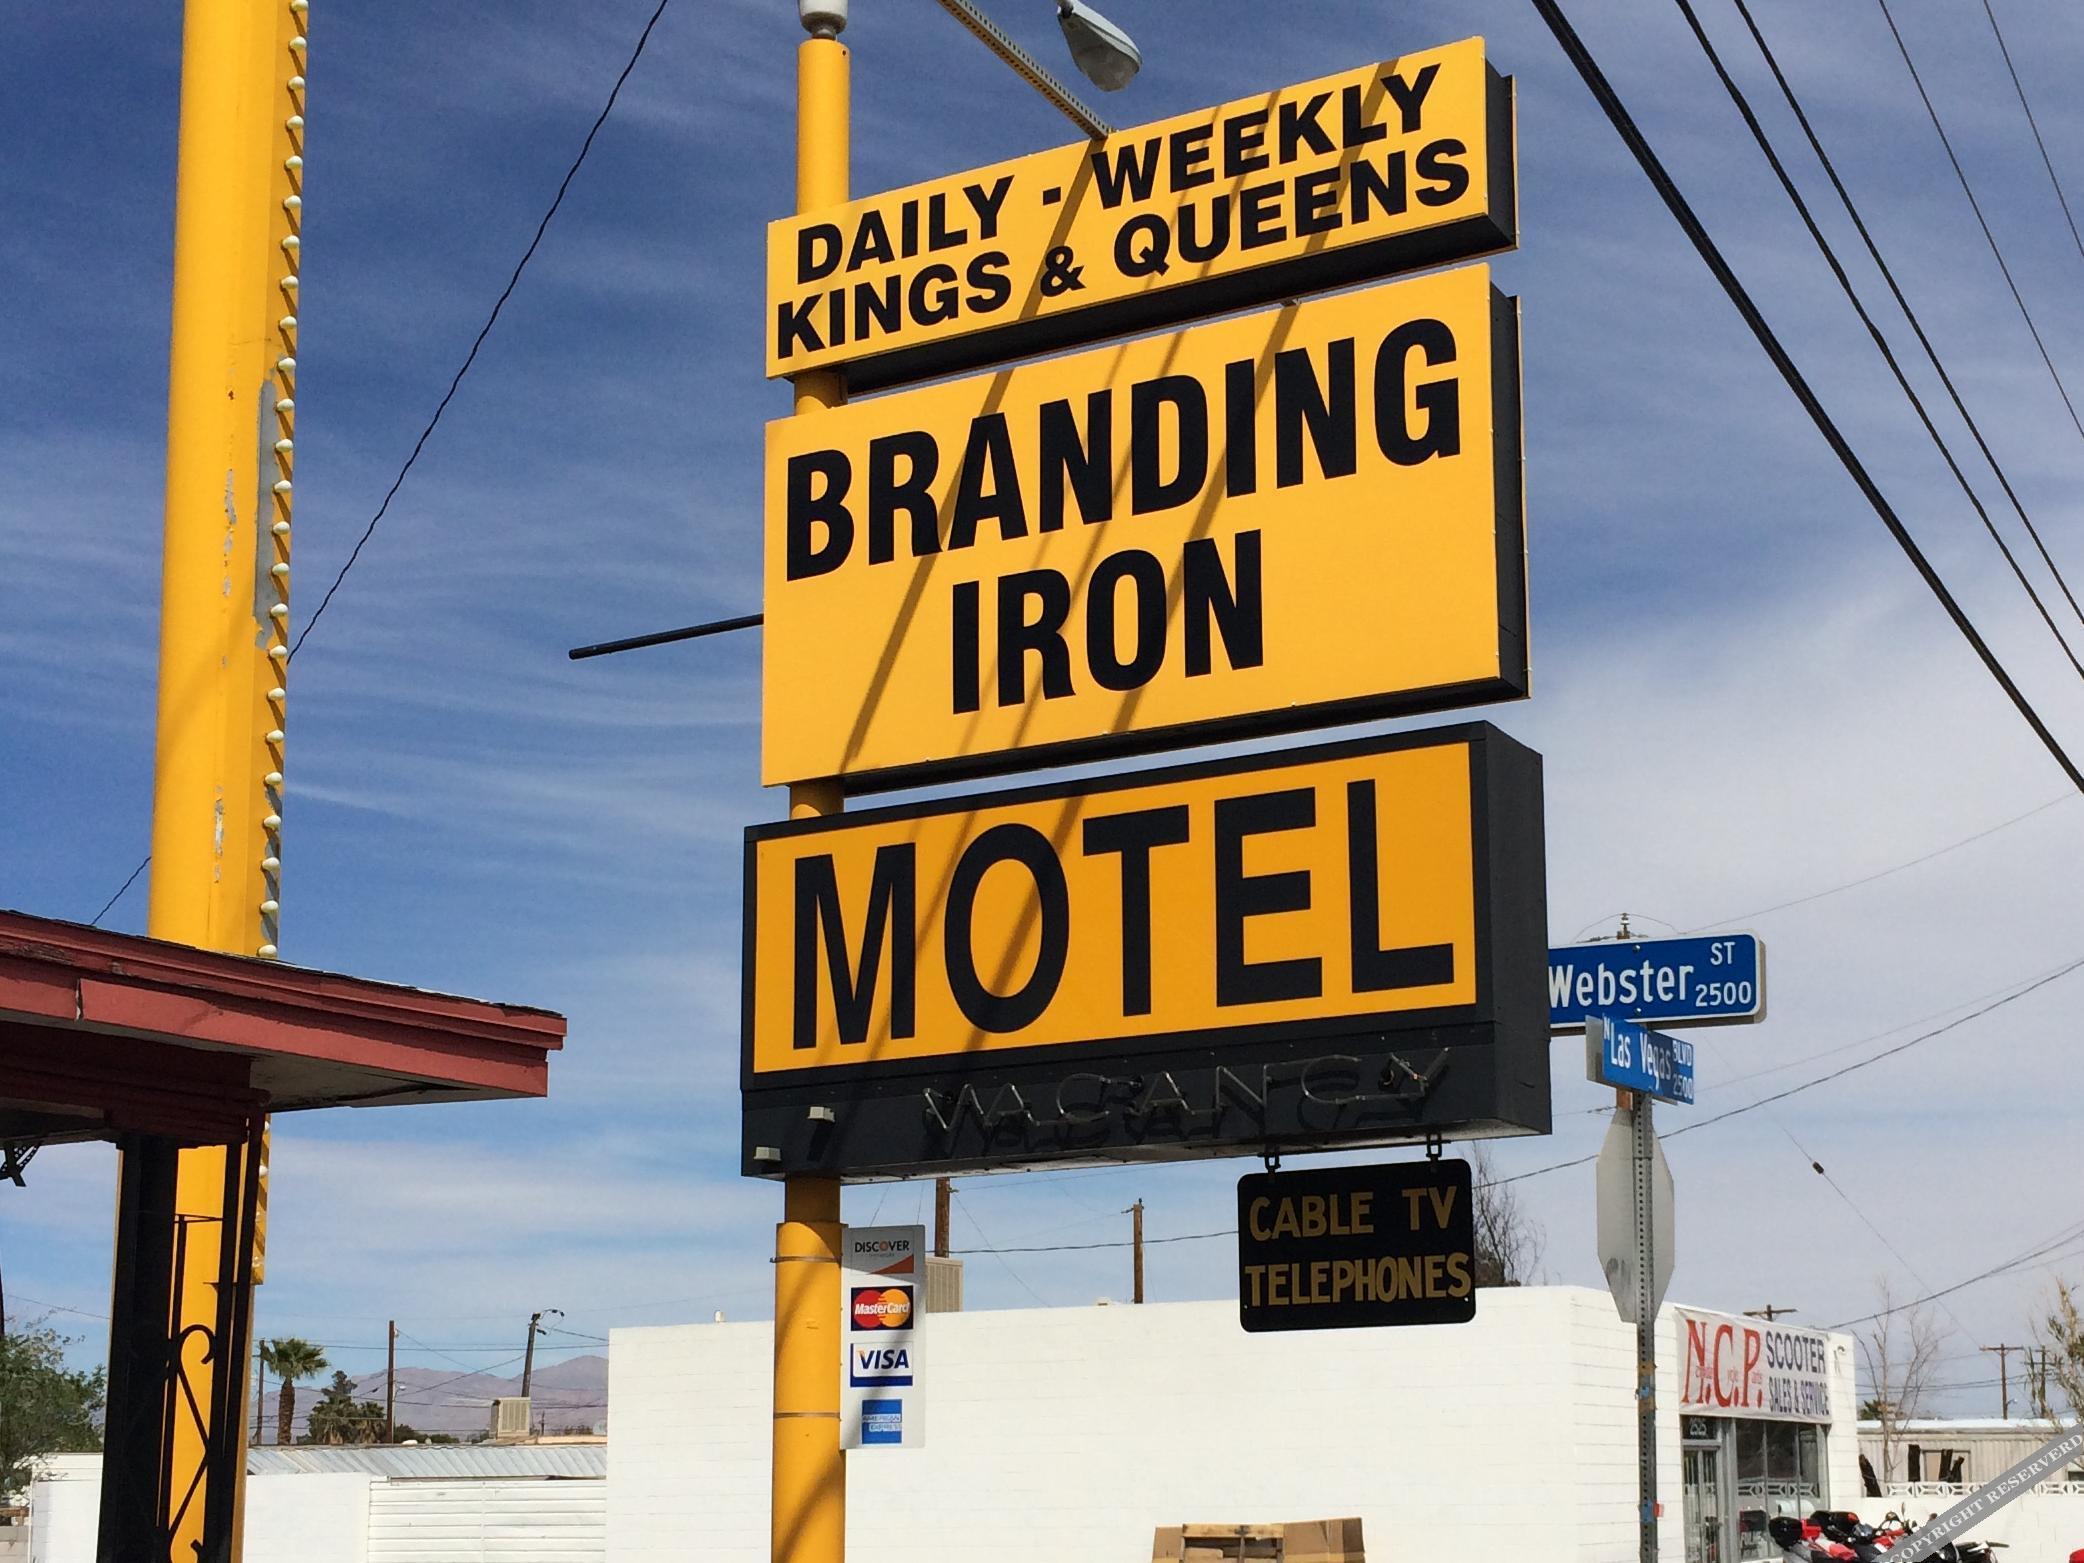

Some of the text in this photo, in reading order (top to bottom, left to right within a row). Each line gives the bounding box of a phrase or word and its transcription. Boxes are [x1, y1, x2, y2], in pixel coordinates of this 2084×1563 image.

[797, 174, 1015, 284] DAILY
[1091, 62, 1442, 210] WEEKLY
[777, 138, 1470, 360] KINGS & QUEENS
[786, 317, 1461, 582] BRANDING
[952, 528, 1264, 715] IRON
[793, 777, 1455, 1050] MOTEL
[1549, 941, 1736, 1008] Webster ST
[1695, 981, 1752, 1007] 2500
[1611, 1022, 1631, 1069] Las
[1640, 1031, 1672, 1091] Vegas
[1672, 1040, 1693, 1067] BLVD
[1249, 1185, 1457, 1242] CABLE TV
[854, 1240, 910, 1253] DISCOVER
[1244, 1251, 1472, 1307] TELEPHONES
[854, 1302, 910, 1315] MasterCard
[858, 1349, 909, 1370] VISA
[1765, 1330, 1827, 1375] SCOOTER
[1768, 1376, 1792, 1414] SALES
[1801, 1379, 1830, 1415] SERVICE
